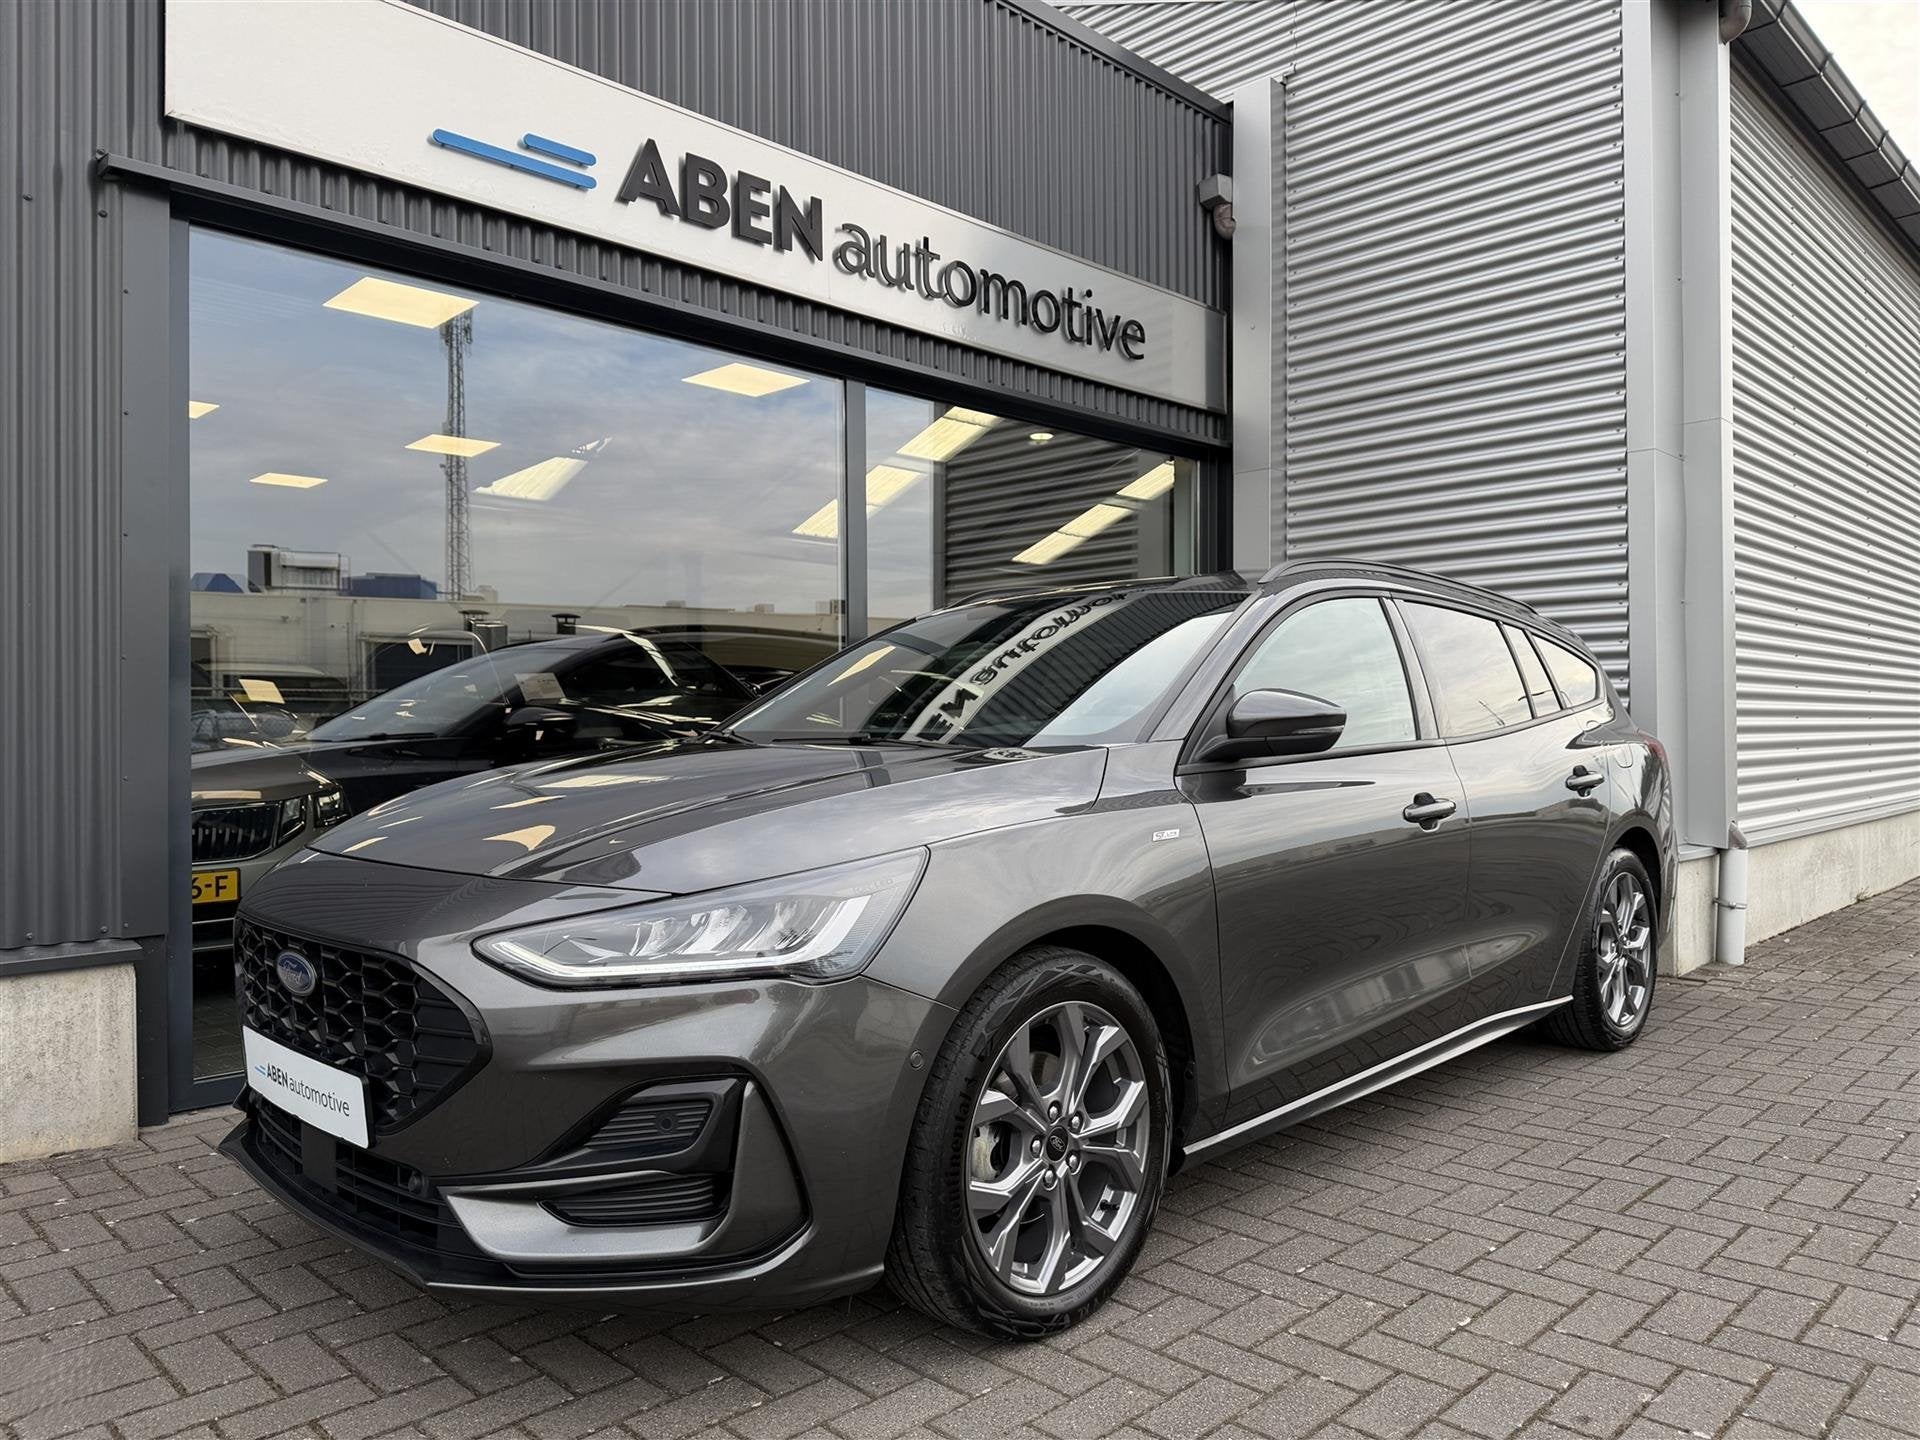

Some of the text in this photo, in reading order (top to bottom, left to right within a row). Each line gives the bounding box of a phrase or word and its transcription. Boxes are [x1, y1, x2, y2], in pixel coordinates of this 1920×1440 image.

[617, 138, 1146, 360] ABEN automotive
[192, 875, 229, 899] 6-F
[266, 1062, 350, 1117] ABEN automotive
